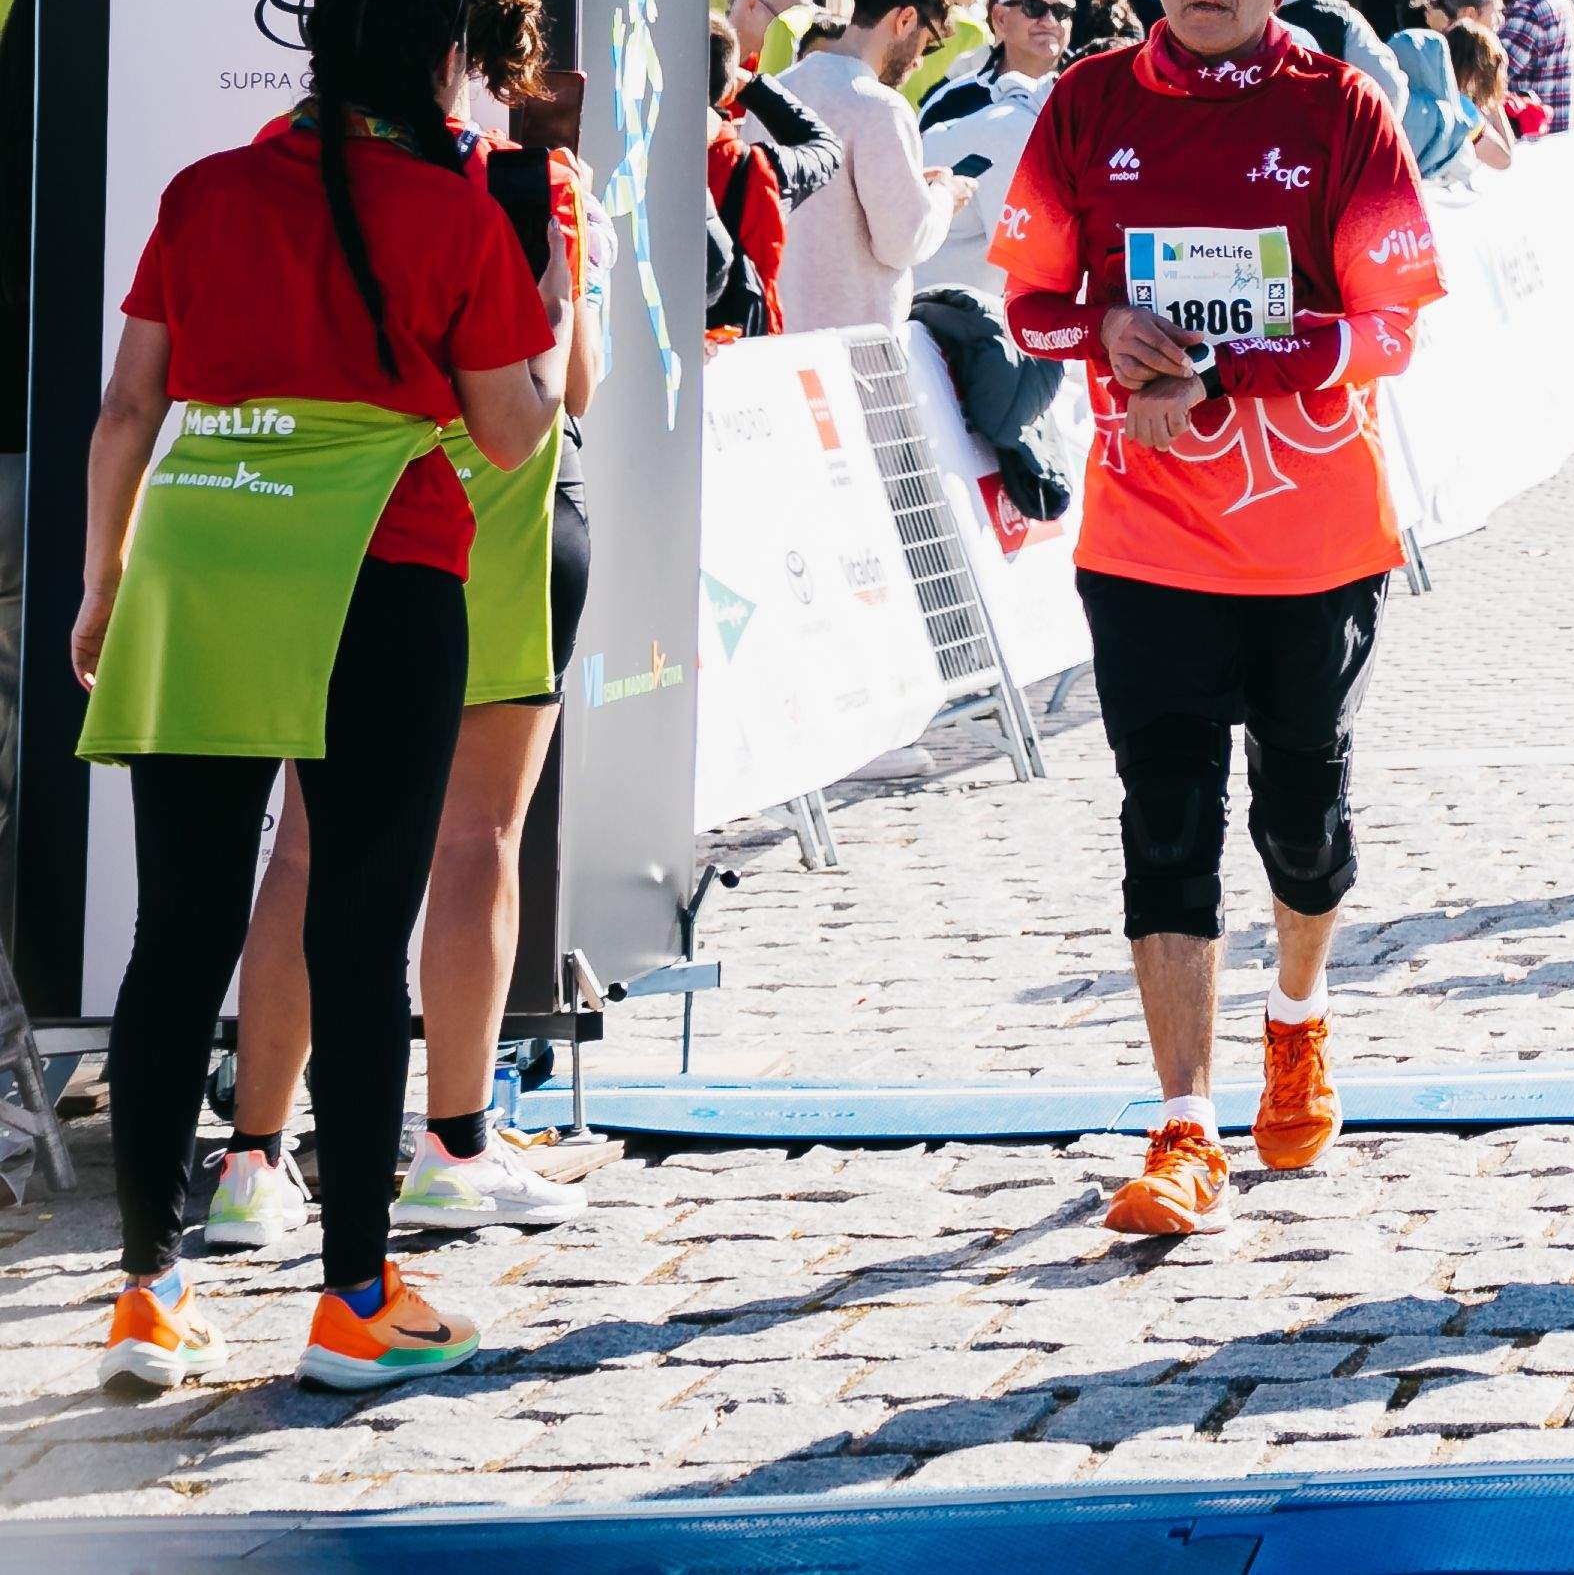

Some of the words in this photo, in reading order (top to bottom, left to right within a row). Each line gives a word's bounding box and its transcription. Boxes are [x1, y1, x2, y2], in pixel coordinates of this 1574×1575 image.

[219, 71, 292, 90] SUPRA
[1189, 244, 1253, 259] MetLife
[1165, 298, 1253, 336] 1806
[185, 407, 296, 436] MetLife
[176, 473, 234, 488] MADRID
